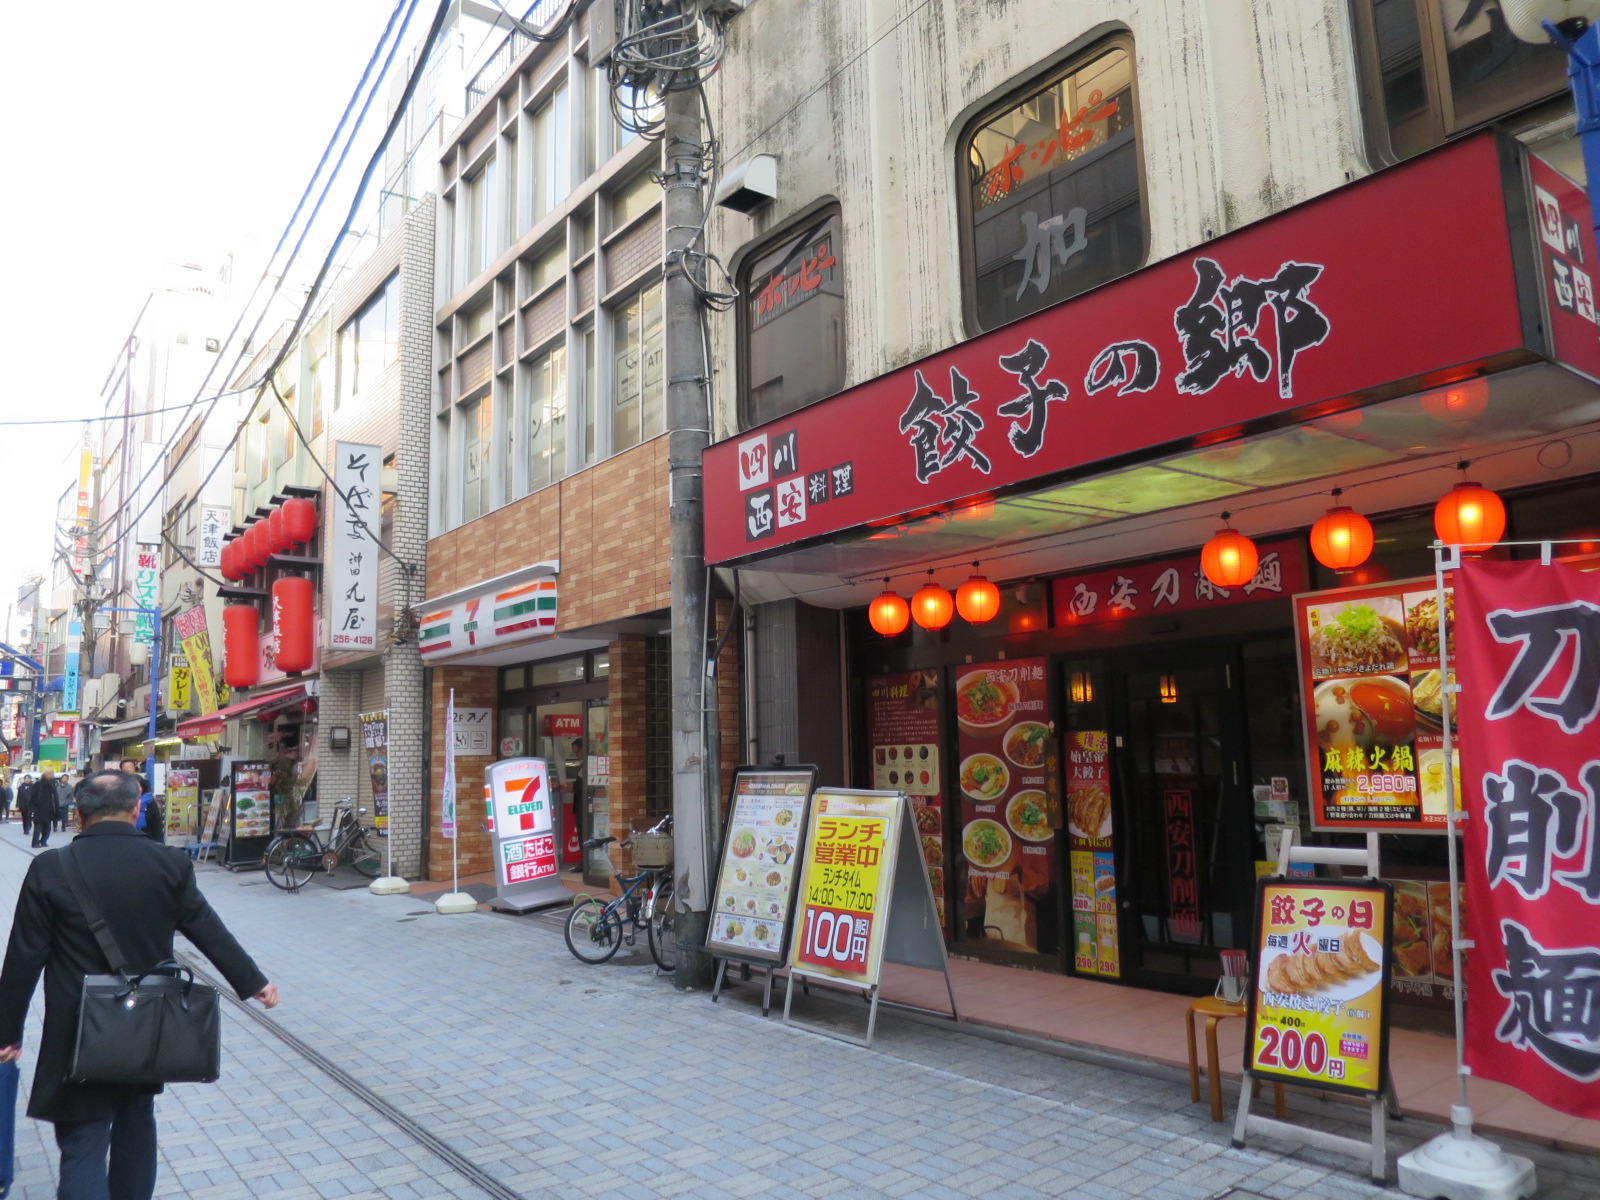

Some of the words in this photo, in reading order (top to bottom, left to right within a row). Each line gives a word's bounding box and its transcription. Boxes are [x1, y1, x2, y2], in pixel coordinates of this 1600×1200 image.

[984, 88, 1119, 198] ホッピー
[1540, 198, 1584, 264] 四川
[1013, 206, 1087, 302] 加
[756, 243, 837, 315] ホッピー
[898, 256, 1331, 485] 餃子の郷
[741, 433, 796, 481] 四川
[808, 464, 852, 503] 料理
[202, 510, 220, 564] 天津飯店
[986, 666, 1044, 683] 西安刀削麺
[555, 718, 580, 728] ATM
[1084, 731, 1107, 750] 復活
[1071, 750, 1104, 764] 始皇帝
[1324, 745, 1414, 773] 麻辣火鍋
[1072, 765, 1105, 779] 大餃子
[1357, 774, 1416, 793] 2,980円
[819, 822, 881, 843] ランチ
[1485, 600, 1600, 1080] 刀削麺
[506, 844, 523, 862] 酒
[525, 838, 554, 858] たばこ
[815, 842, 881, 868] 営業中
[510, 862, 555, 880] 銀行ATM
[823, 868, 861, 888] ランチタイム
[809, 886, 834, 905] 14:00
[846, 891, 873, 911] 17:00
[1270, 895, 1373, 929] 餃子の日
[806, 908, 853, 962] 100
[854, 919, 869, 936] 割引
[1268, 935, 1288, 948] 毎週
[1292, 931, 1312, 956] 火
[1318, 939, 1340, 952] 曜日
[1257, 1026, 1344, 1079] 200円
